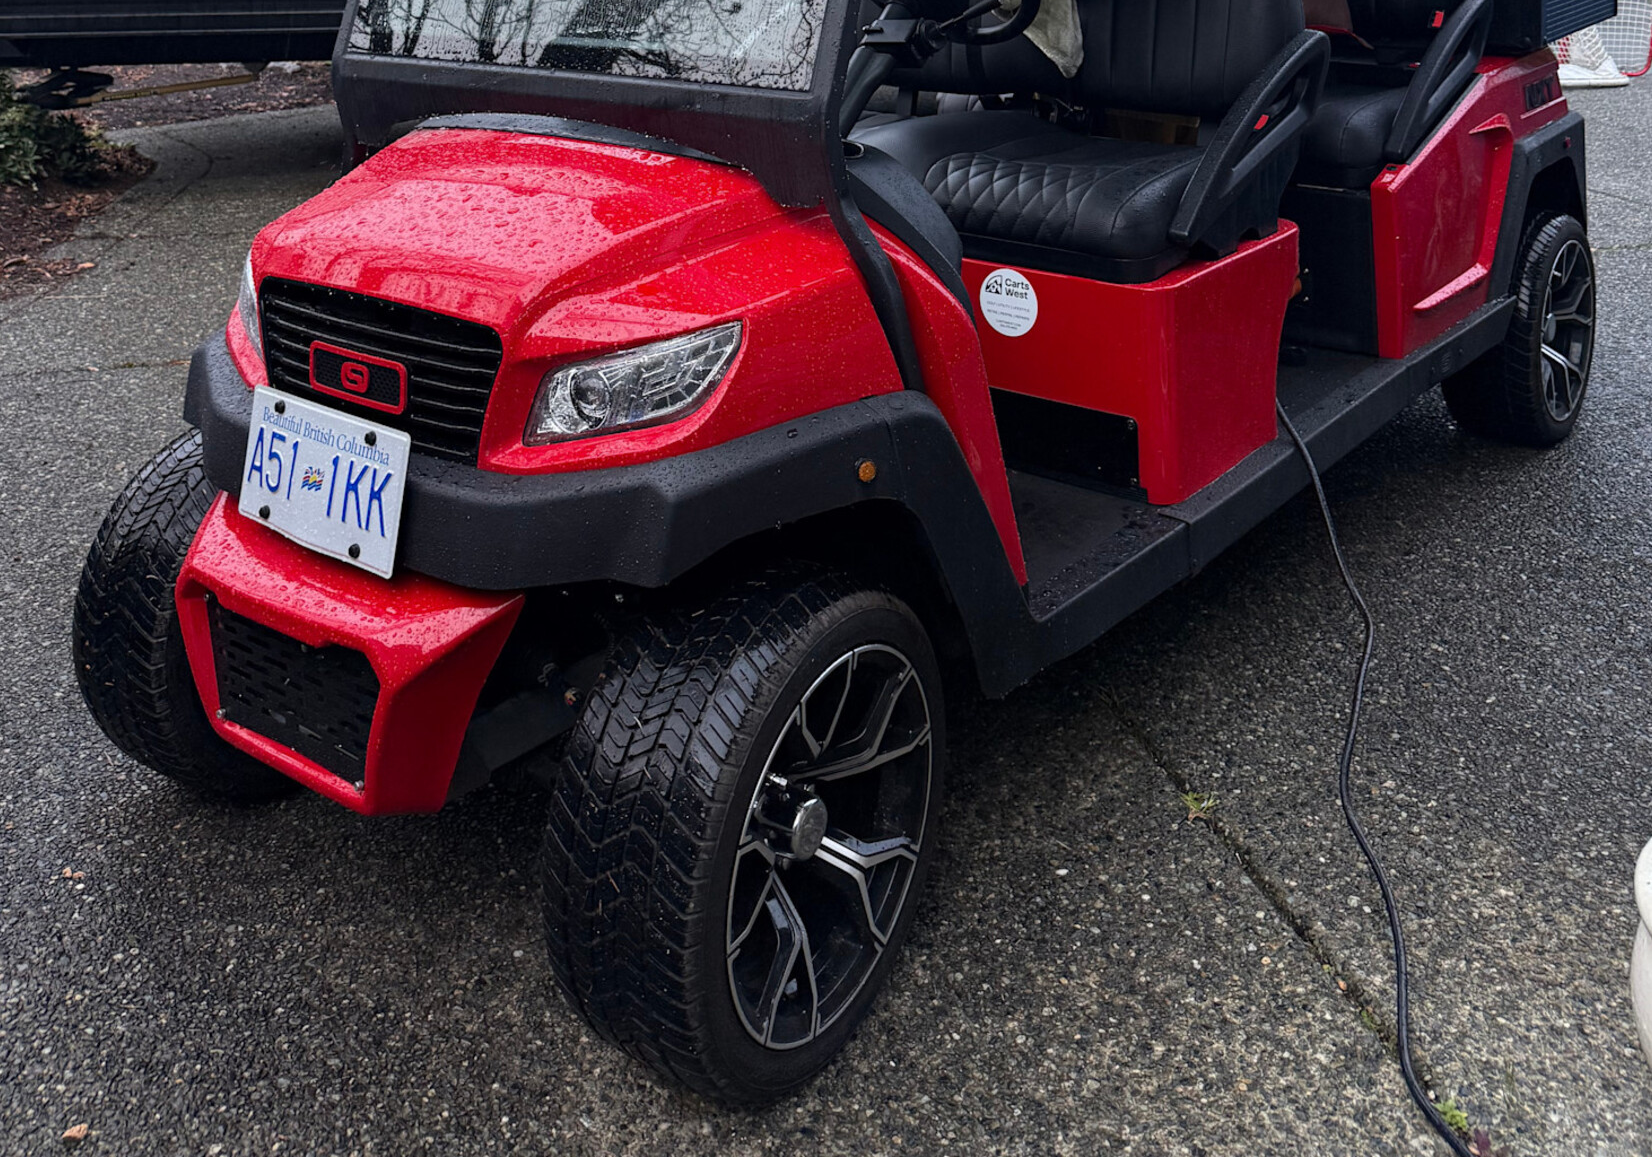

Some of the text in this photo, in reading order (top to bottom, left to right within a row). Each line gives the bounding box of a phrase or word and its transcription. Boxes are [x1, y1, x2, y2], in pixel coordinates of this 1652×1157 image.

[1005, 278, 1030, 290] Carts
[1005, 288, 1028, 300] West
[263, 406, 390, 466] Beautiful British Columbia
[247, 426, 393, 537] A51 1KK
